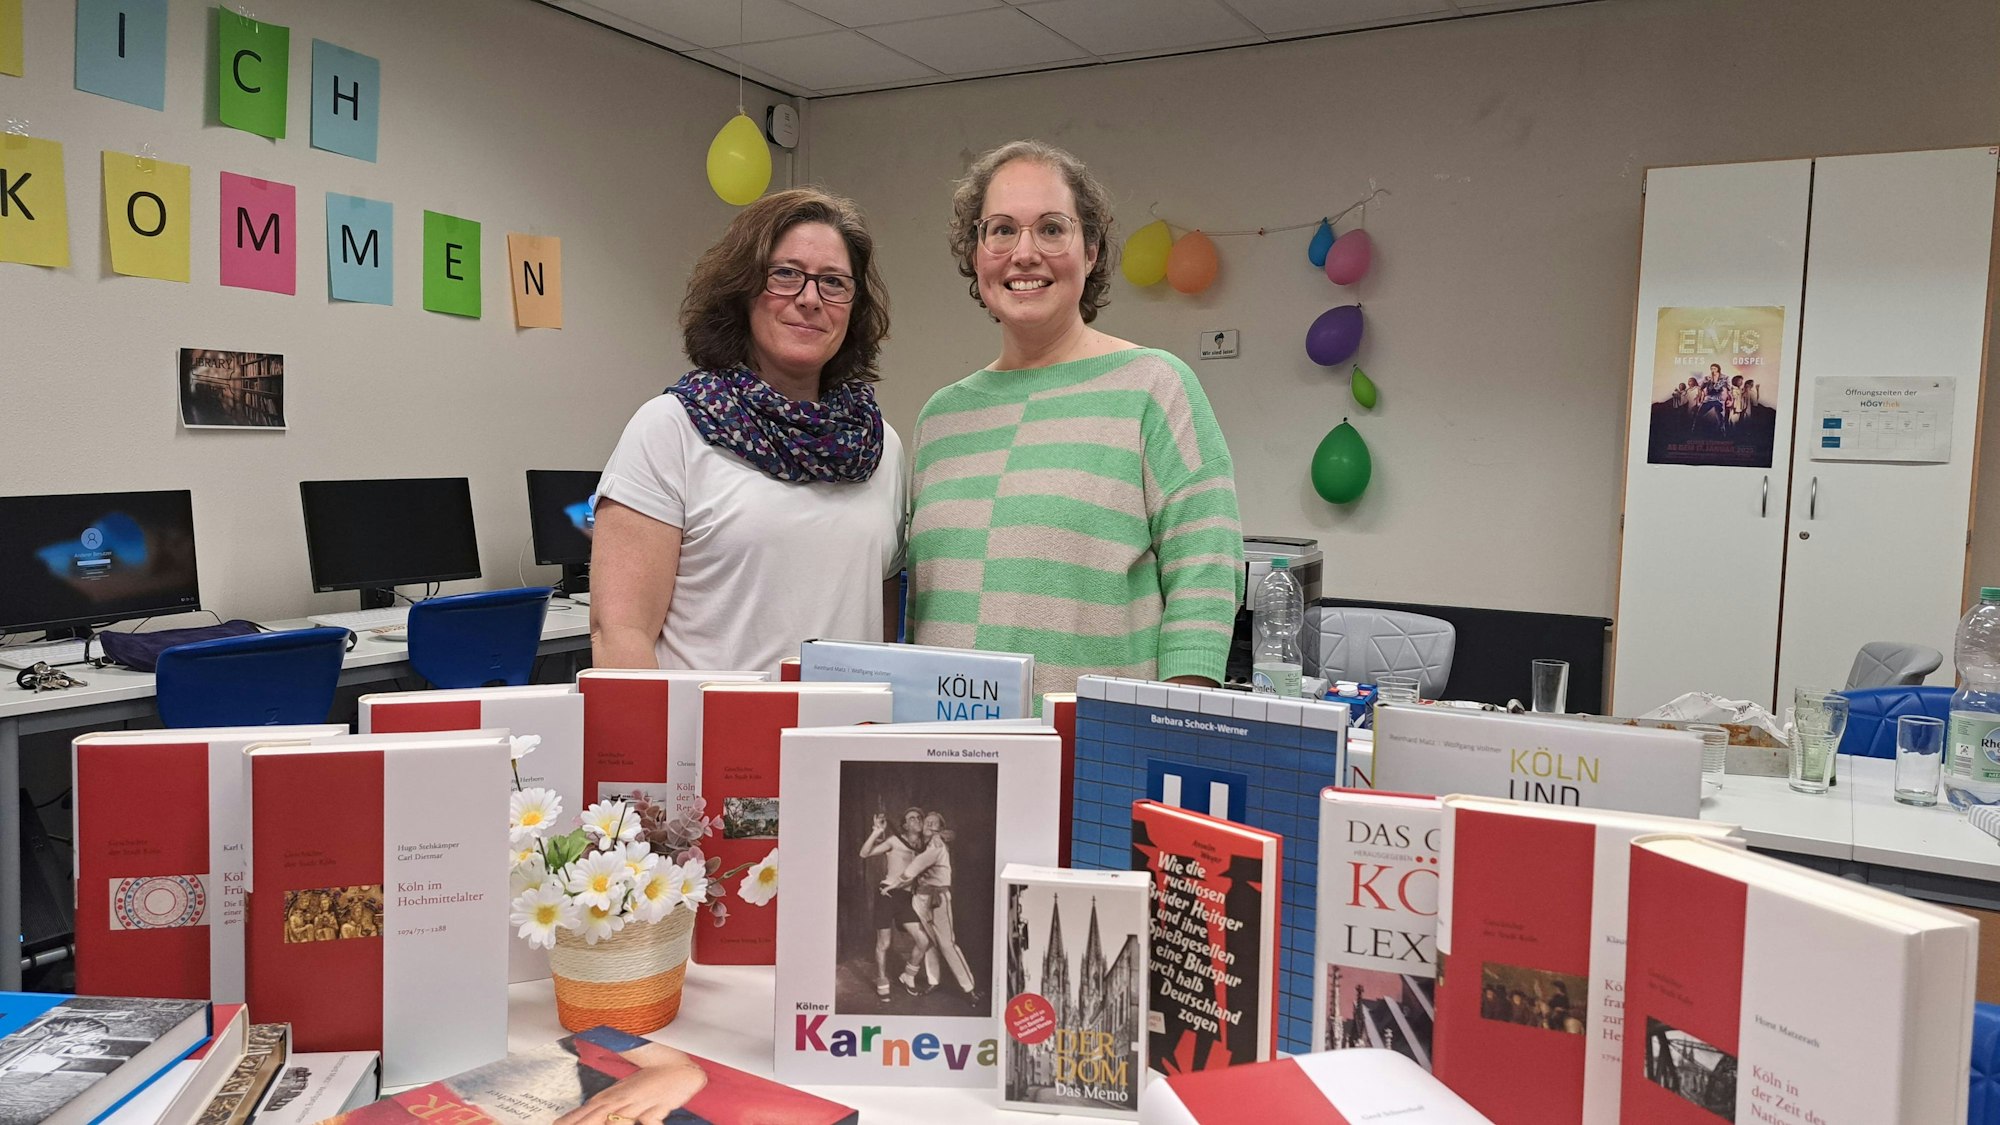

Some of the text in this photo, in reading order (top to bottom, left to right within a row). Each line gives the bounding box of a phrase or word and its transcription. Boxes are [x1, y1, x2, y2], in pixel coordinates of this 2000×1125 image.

[1679, 329, 1760, 354] ELVIS
[1675, 357, 1764, 366] MEETS GOSPEL
[1845, 388, 1902, 397] Öffnungszeiten
[937, 673, 999, 701] KÖLN
[1150, 714, 1249, 736] Barbara Schock-Werner
[926, 748, 999, 759] Monika Salchert
[1510, 746, 1599, 784] KÖLN
[397, 843, 417, 852] Hugo
[1347, 820, 1411, 849] DAS
[224, 871, 245, 882] Köl
[1158, 850, 1206, 878] Wie die
[397, 881, 442, 892] Köln im
[397, 892, 485, 907] Hochmittelalter
[1163, 873, 1226, 904] ruchlosen
[1149, 880, 1244, 932] Brüder Heitger
[1156, 908, 1208, 939] und ihre
[1149, 960, 1205, 993] urch halb
[1156, 944, 1243, 988] eine Blutspur
[795, 1002, 830, 1012] Kölner
[1160, 978, 1243, 1026] Deutschland
[1177, 1008, 1219, 1034] zogen
[1057, 1028, 1116, 1058] DER
[1056, 1054, 1129, 1087] DOM
[1752, 1065, 1799, 1097] Köln in
[1055, 1081, 1129, 1103] Das Memo
[1751, 1085, 1773, 1104] der
[1775, 1094, 1801, 1118] Zeit
